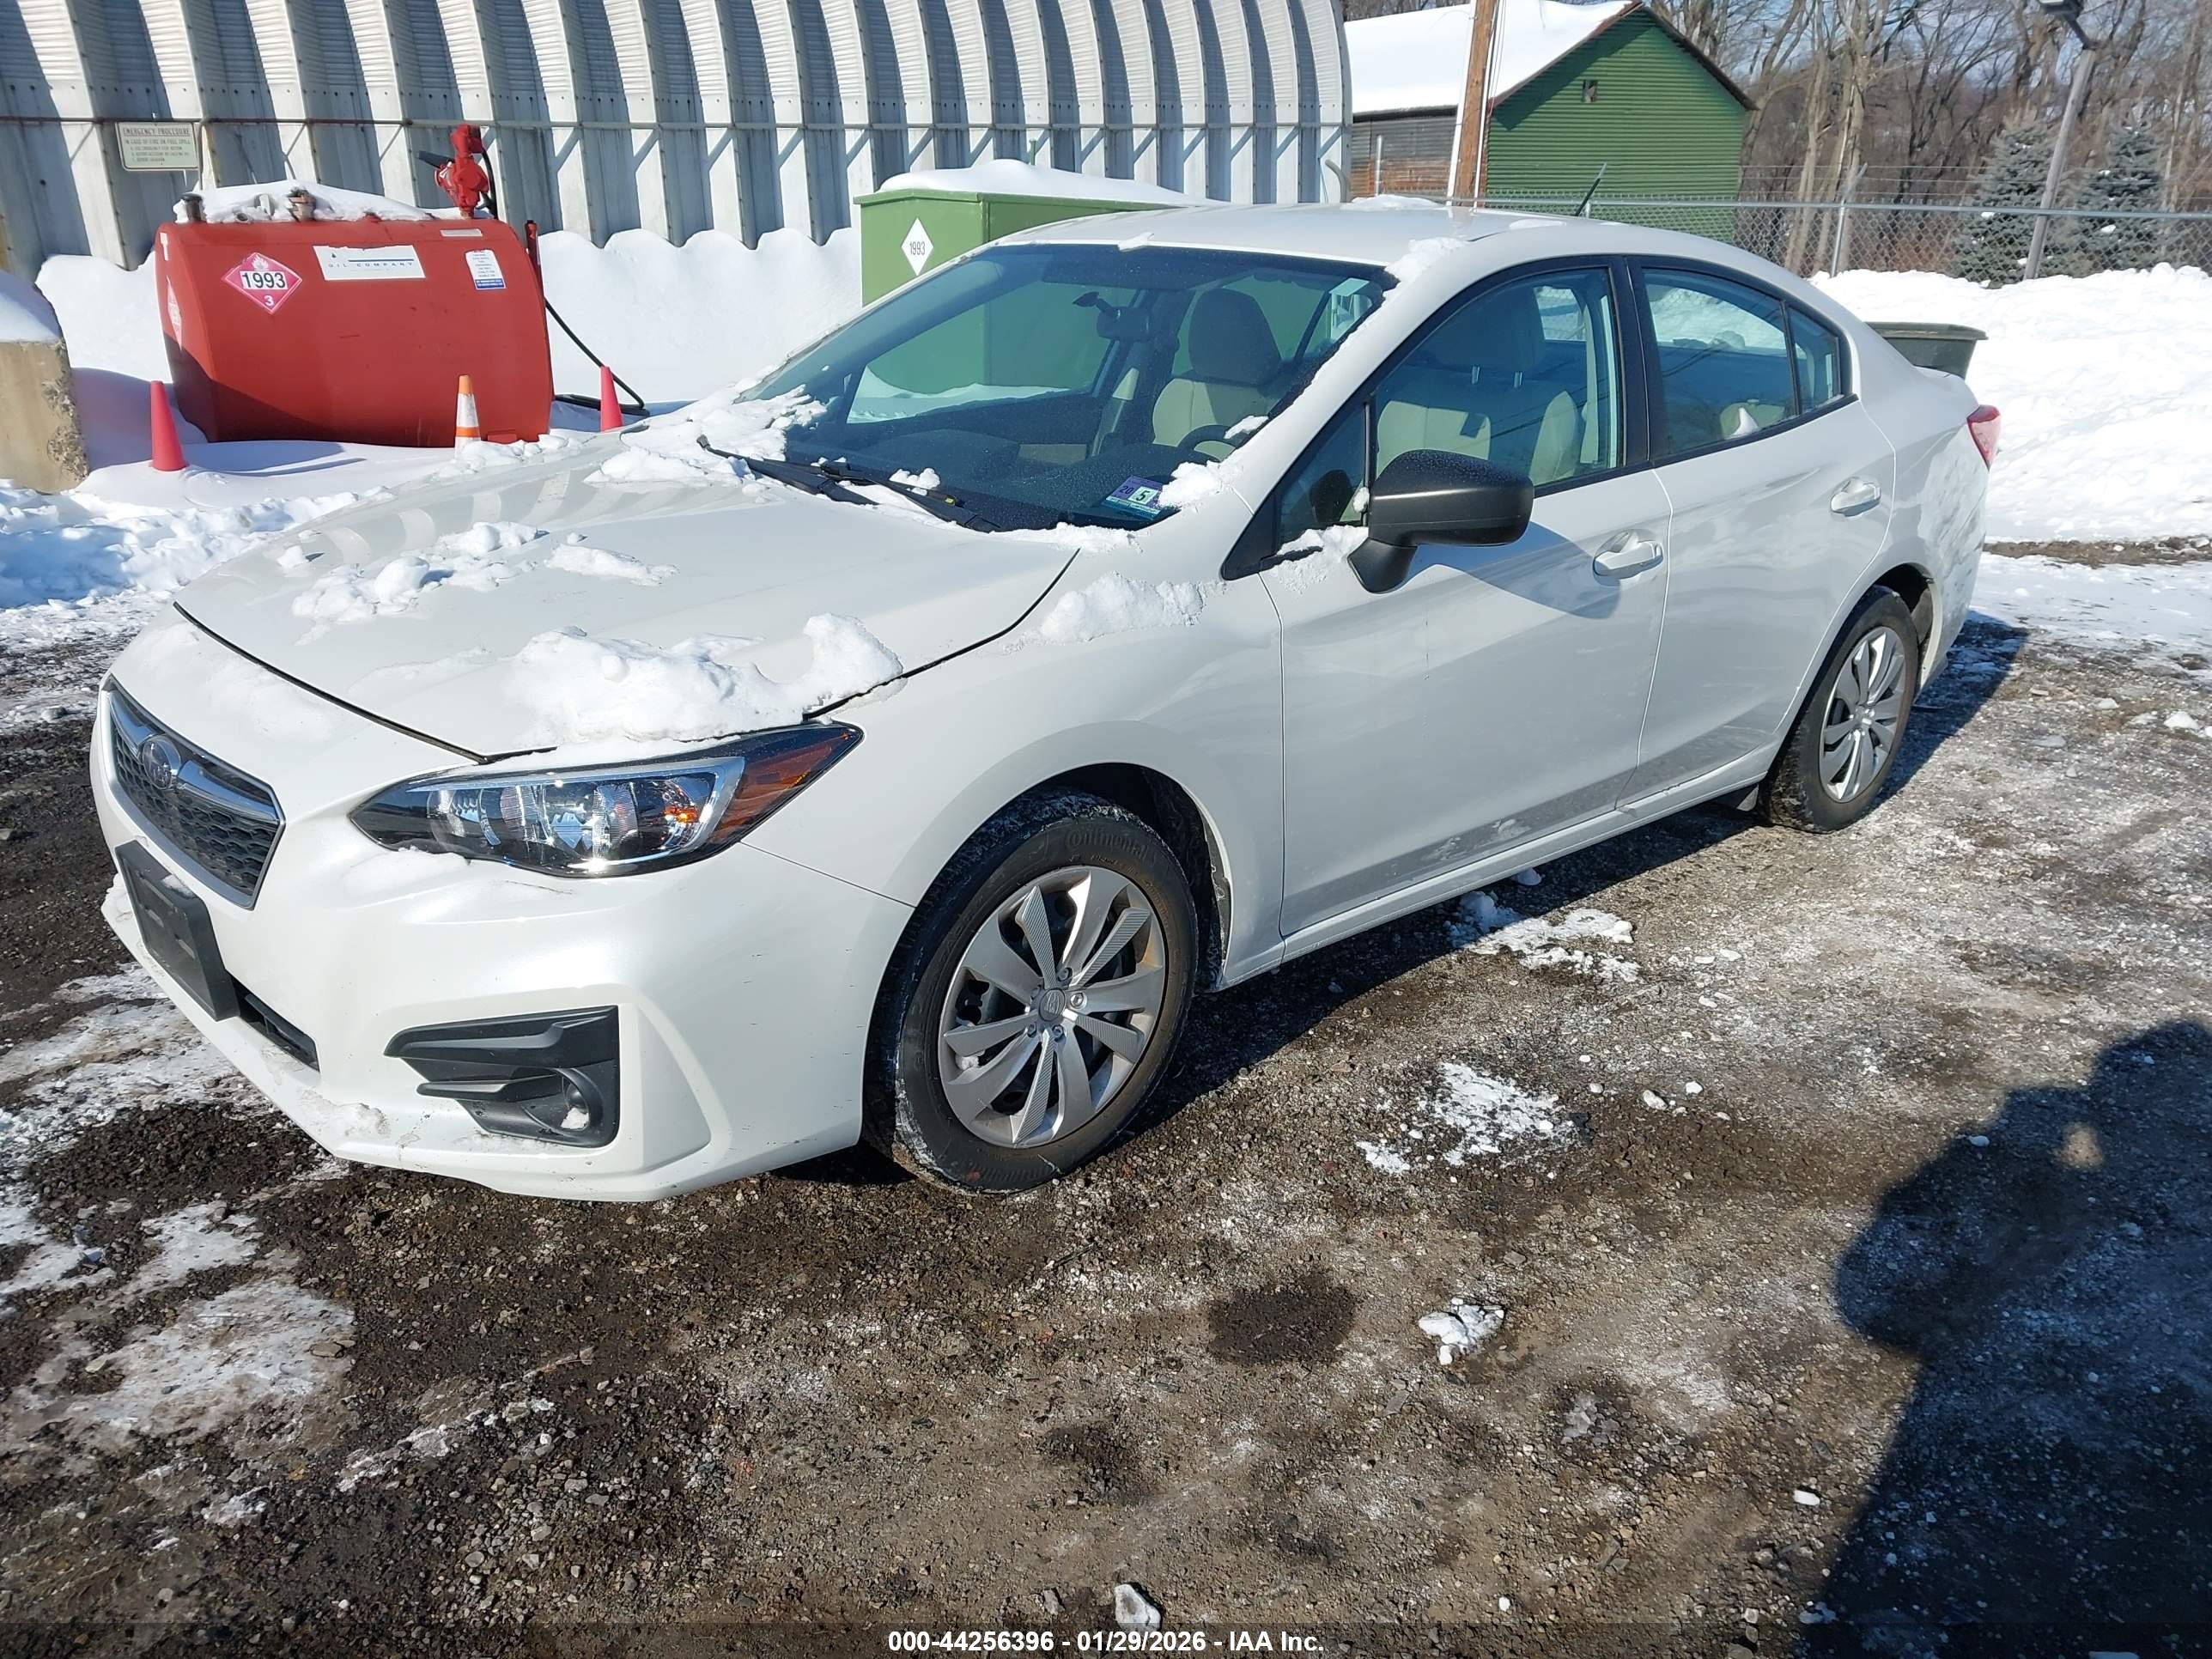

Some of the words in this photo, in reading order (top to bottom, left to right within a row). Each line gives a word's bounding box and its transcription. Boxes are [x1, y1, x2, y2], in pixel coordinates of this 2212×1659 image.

[909, 241, 926, 255] 1993
[242, 272, 285, 289] 1993
[264, 295, 274, 306] 3
[1136, 489, 1151, 501] 5
